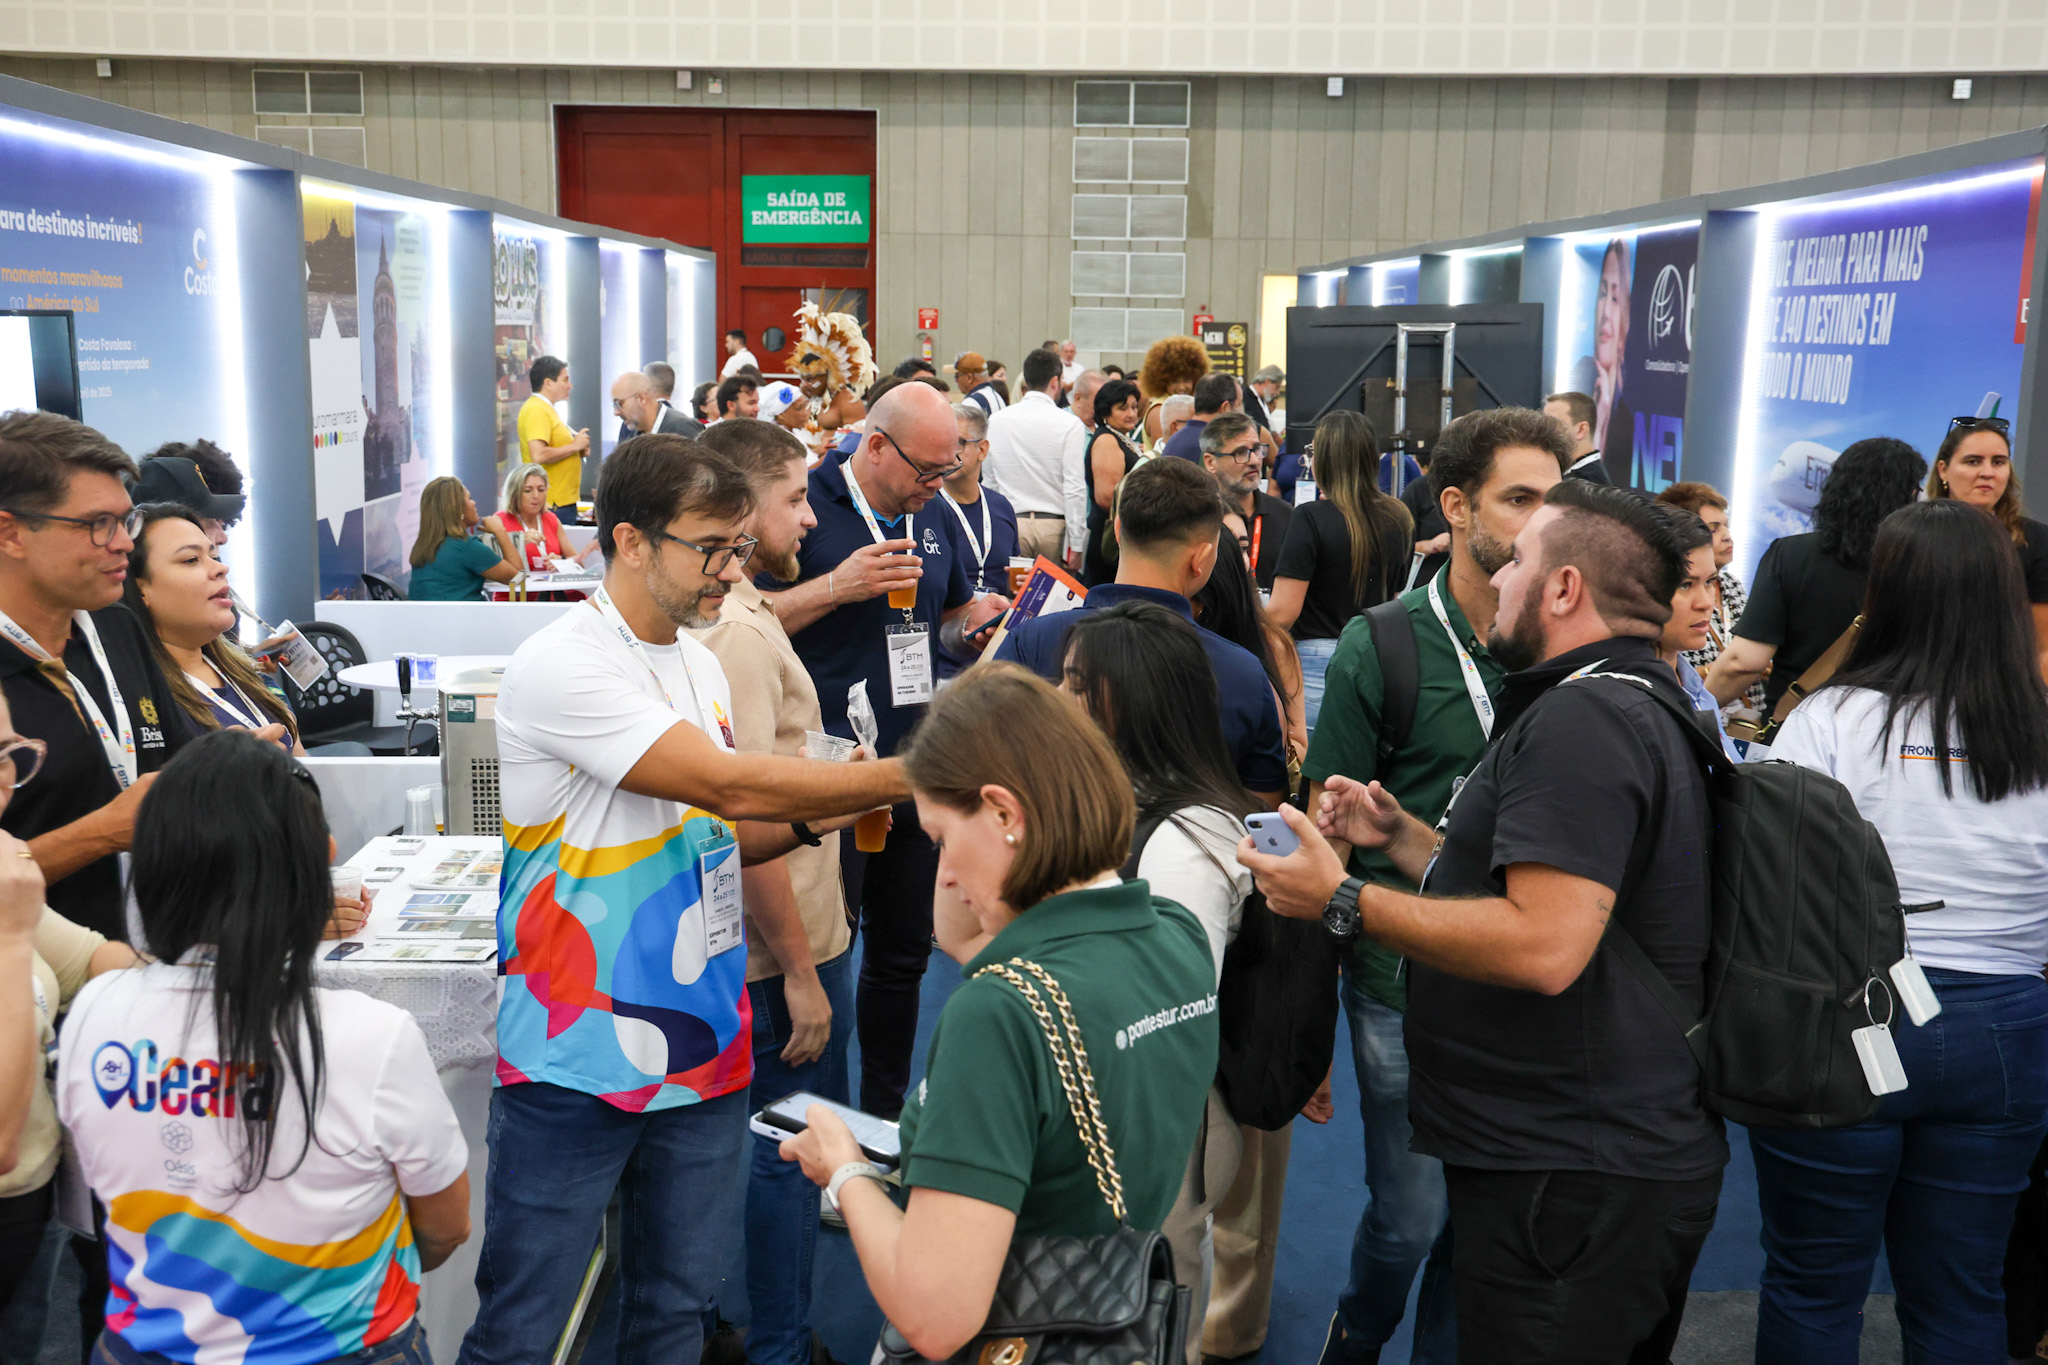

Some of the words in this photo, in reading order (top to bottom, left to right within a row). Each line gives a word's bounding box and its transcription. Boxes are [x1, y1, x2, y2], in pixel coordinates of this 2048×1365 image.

[767, 189, 820, 207] SAÍDA
[823, 192, 846, 207] DE
[751, 207, 863, 226] EMERGÊNCIA
[27, 208, 85, 238] destinos
[86, 213, 142, 244] incríveis!
[1792, 234, 1846, 287] MELHOR
[1844, 230, 1884, 285] PARA
[1883, 224, 1928, 282] MAIS
[1, 266, 59, 285] momentos
[60, 268, 124, 289] maravilhosos
[84, 296, 100, 313] Sul
[1780, 295, 1806, 344] 140
[1804, 293, 1871, 346] DESTINOS
[1868, 292, 1897, 346] EM
[79, 338, 100, 351] Costa
[101, 338, 132, 351] Favolosa
[1790, 352, 1803, 401] O
[1801, 353, 1853, 405] MUNDO
[922, 538, 942, 556] brt
[618, 626, 632, 643] BTM
[906, 653, 924, 661] BTM
[1481, 700, 1492, 716] BTM
[719, 872, 735, 887] BTM
[1127, 992, 1218, 1048] pontestur.com.br
